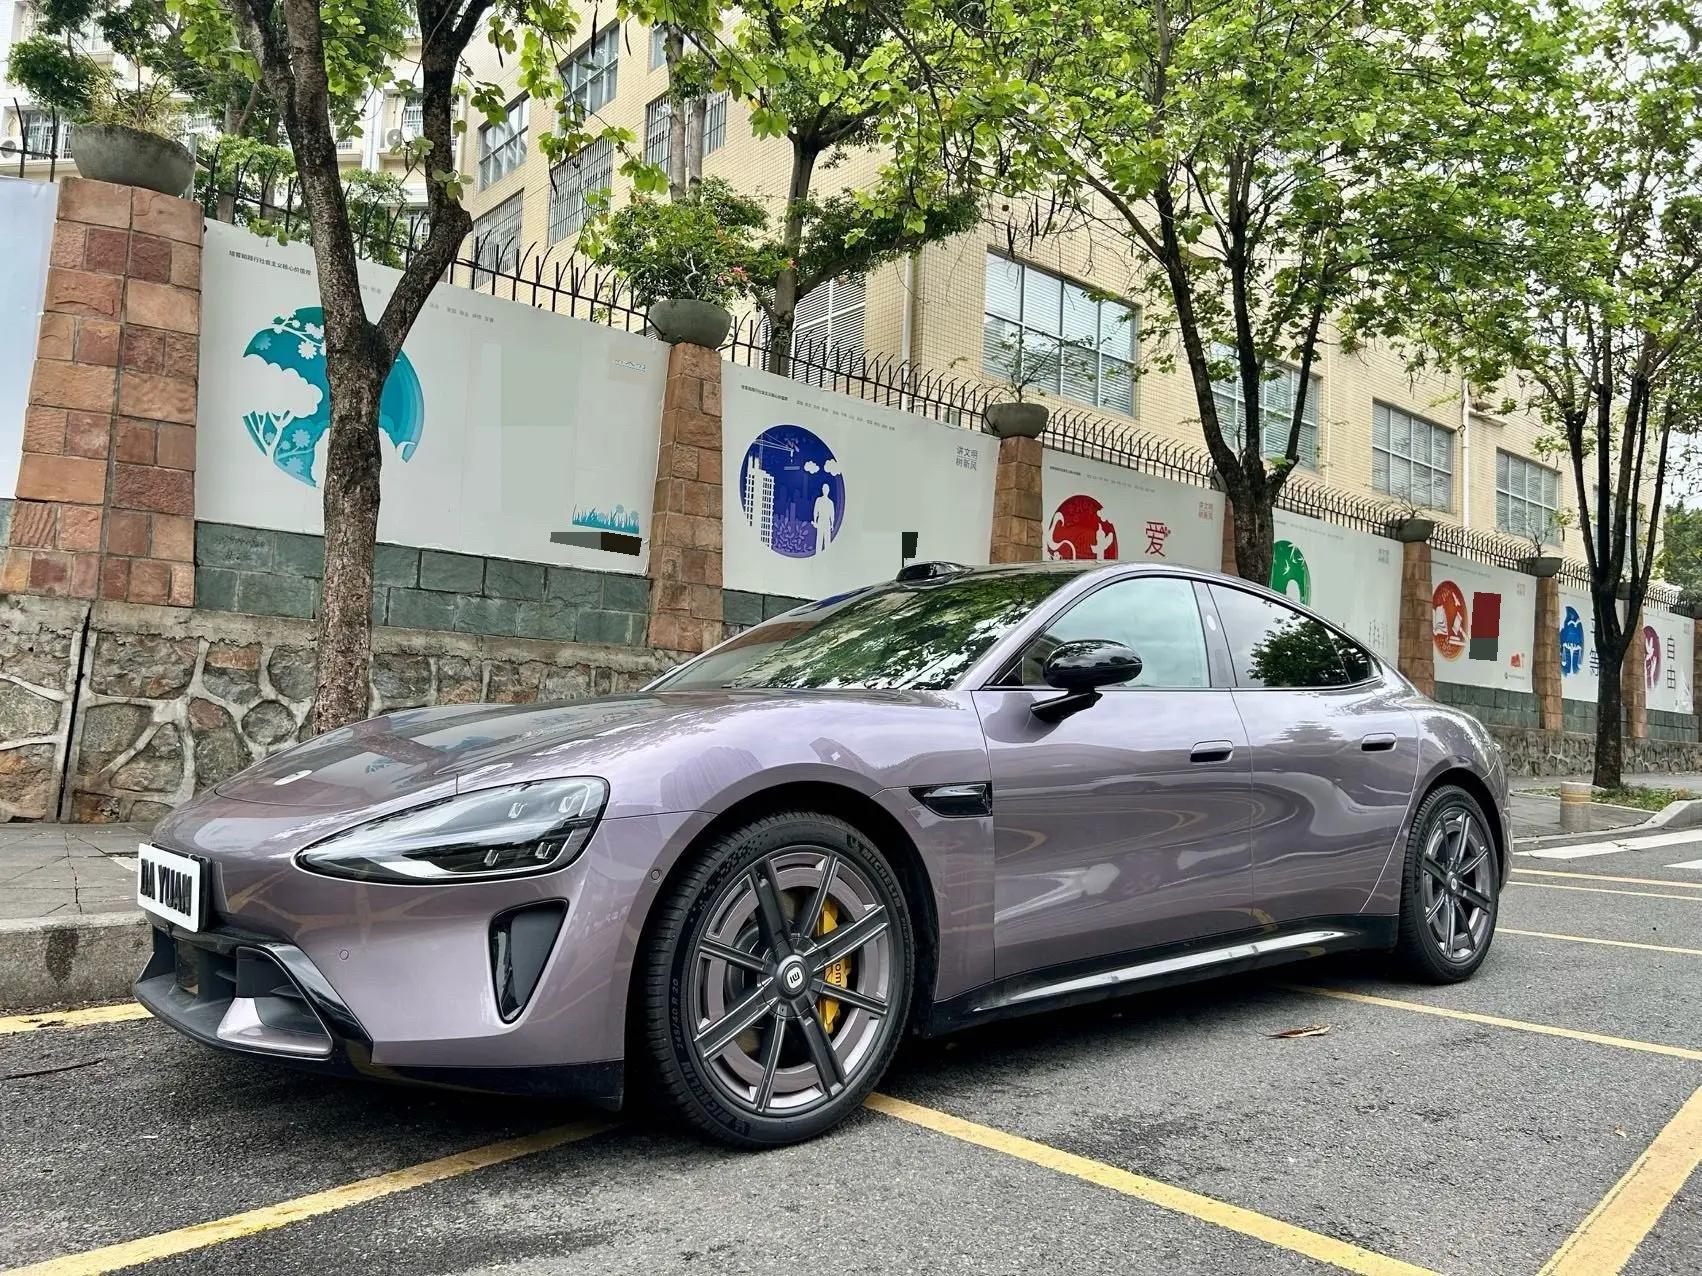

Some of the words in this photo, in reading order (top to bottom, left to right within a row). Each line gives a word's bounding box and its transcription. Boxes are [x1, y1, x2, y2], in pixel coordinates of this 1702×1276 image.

[1145, 521, 1167, 557] 爱
[140, 858, 155, 900] DA
[158, 864, 192, 917] YUAN
